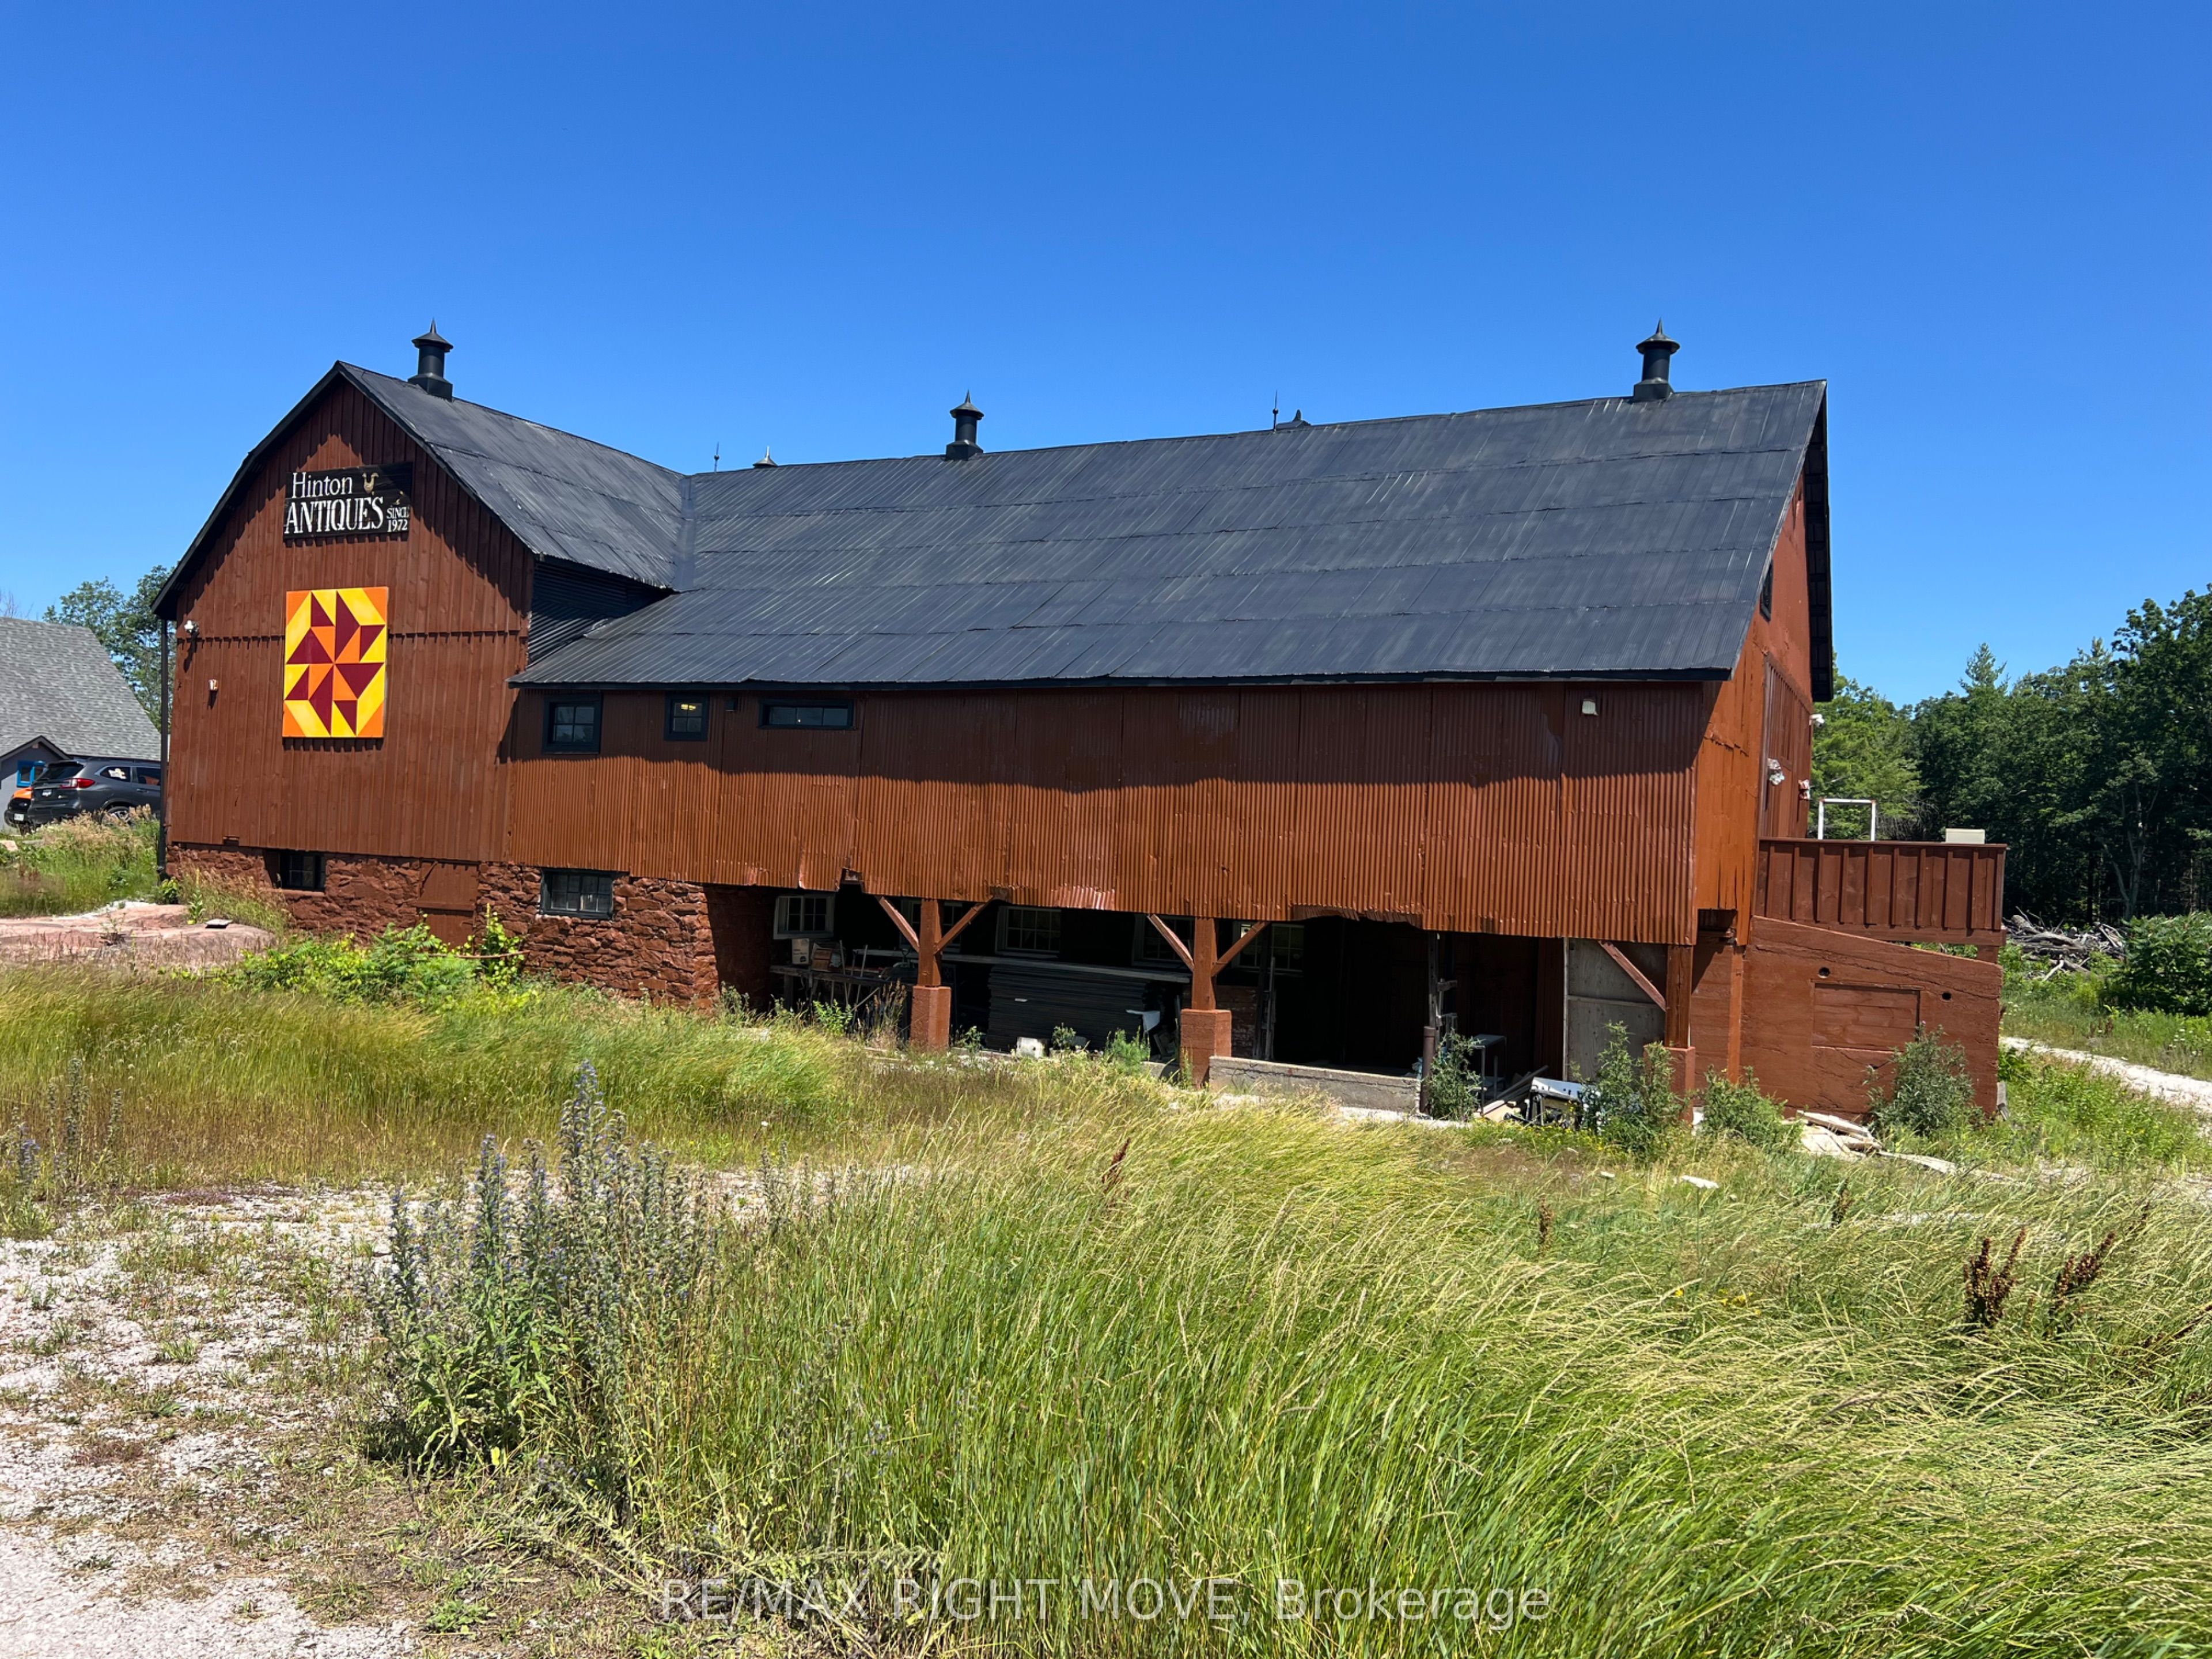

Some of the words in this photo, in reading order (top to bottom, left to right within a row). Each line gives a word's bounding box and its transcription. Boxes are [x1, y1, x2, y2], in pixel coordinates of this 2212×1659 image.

[291, 472, 353, 498] Hinton
[284, 497, 384, 534] ANTIQUES
[387, 518, 408, 532] 1972
